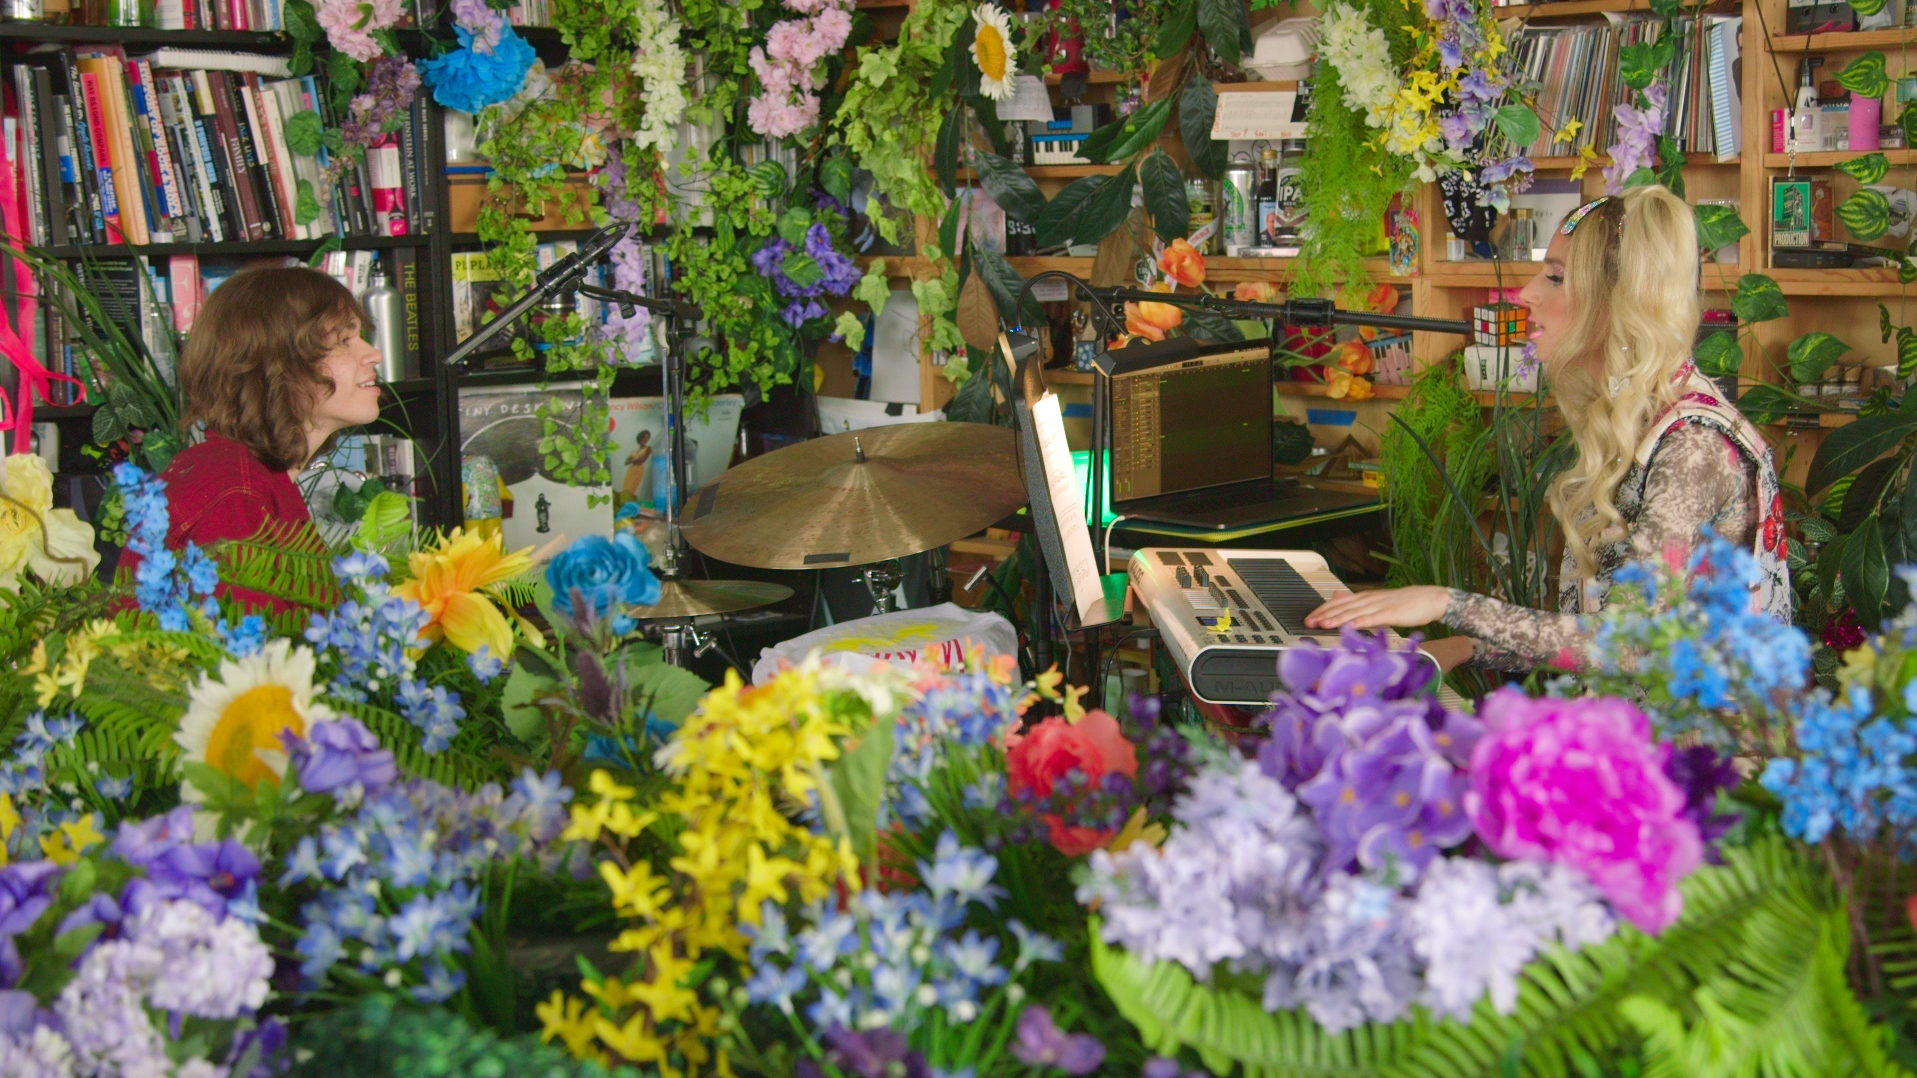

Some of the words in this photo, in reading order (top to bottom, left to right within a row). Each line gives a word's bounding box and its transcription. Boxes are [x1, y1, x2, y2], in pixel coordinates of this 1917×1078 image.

[86, 80, 94, 95] WAY
[88, 96, 98, 126] BEYOND
[94, 128, 106, 162] COMPARE
[407, 160, 414, 169] AT
[408, 171, 417, 200] WORK
[1280, 186, 1304, 202] IPA
[1008, 220, 1036, 234] 9:3
[1774, 232, 1808, 246] PRODUCTION
[404, 262, 416, 289] THE
[404, 293, 419, 351] BEATLES
[458, 406, 489, 416] INY
